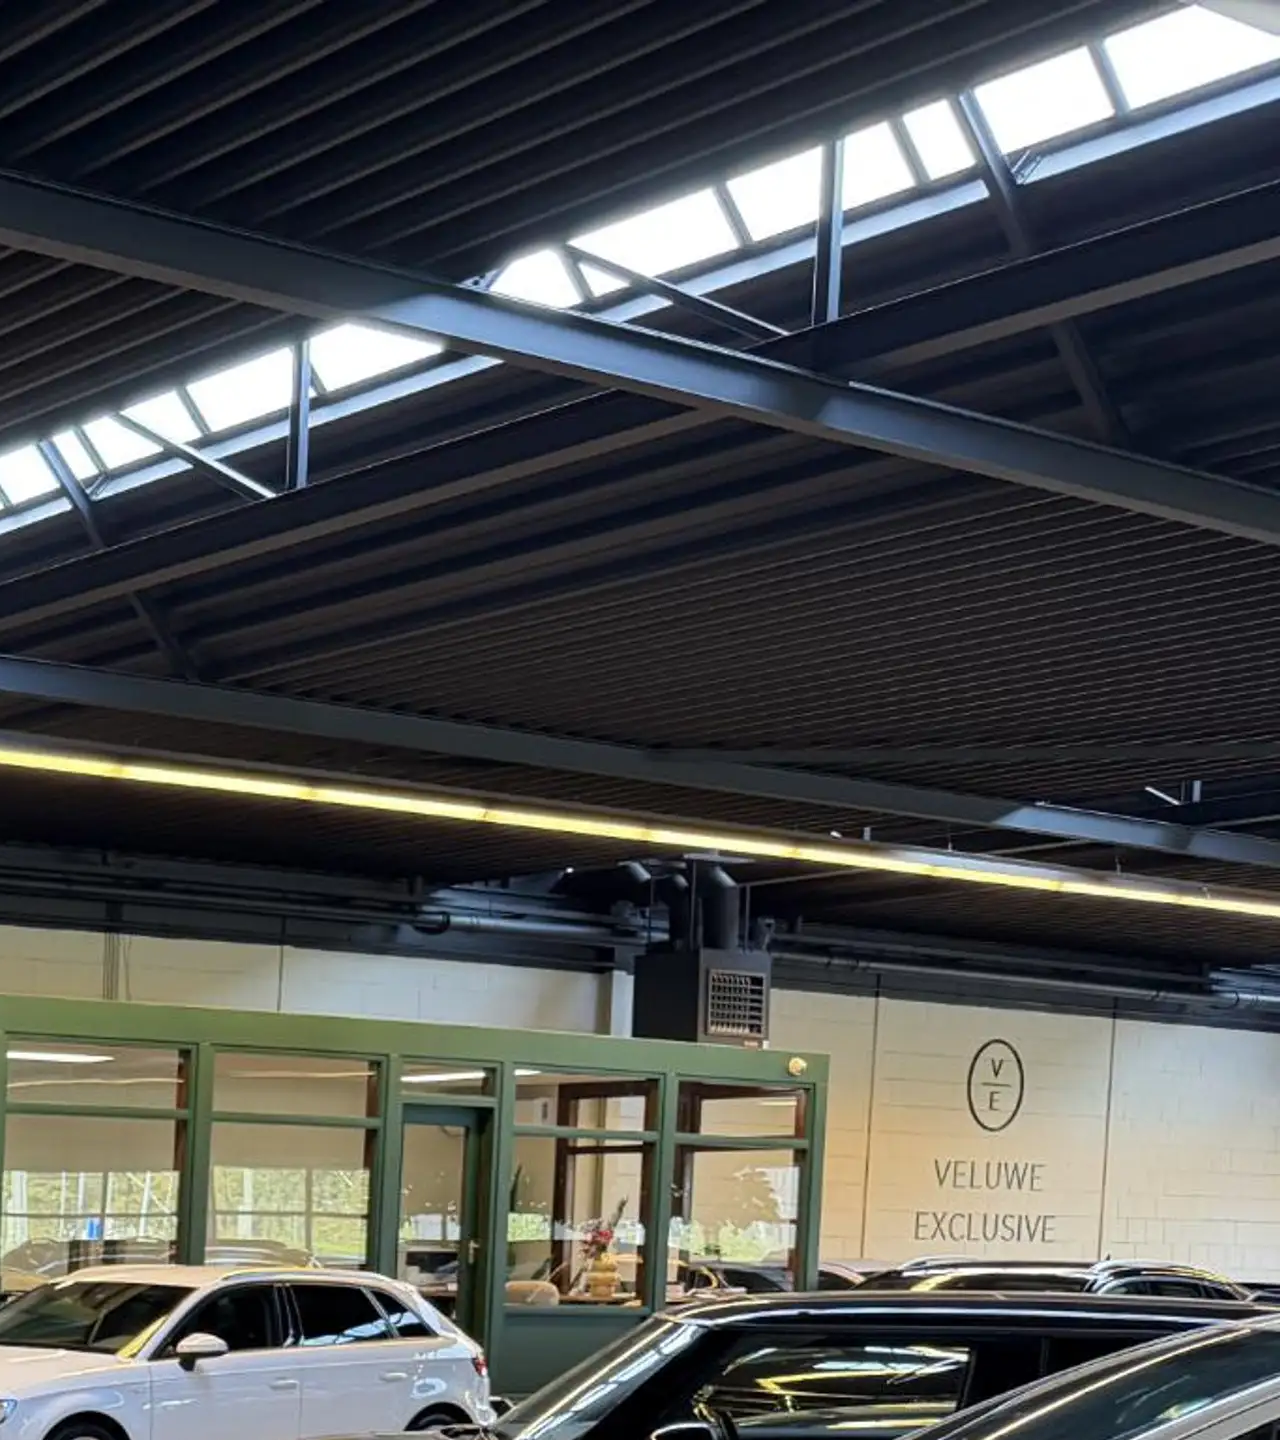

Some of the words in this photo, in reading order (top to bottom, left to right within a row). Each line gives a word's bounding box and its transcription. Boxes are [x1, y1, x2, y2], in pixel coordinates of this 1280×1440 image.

[990, 1057, 1004, 1078] V
[988, 1091, 1001, 1111] E
[934, 1159, 1048, 1192] VELUWE
[914, 1211, 1056, 1243] EXCLUSIVE
